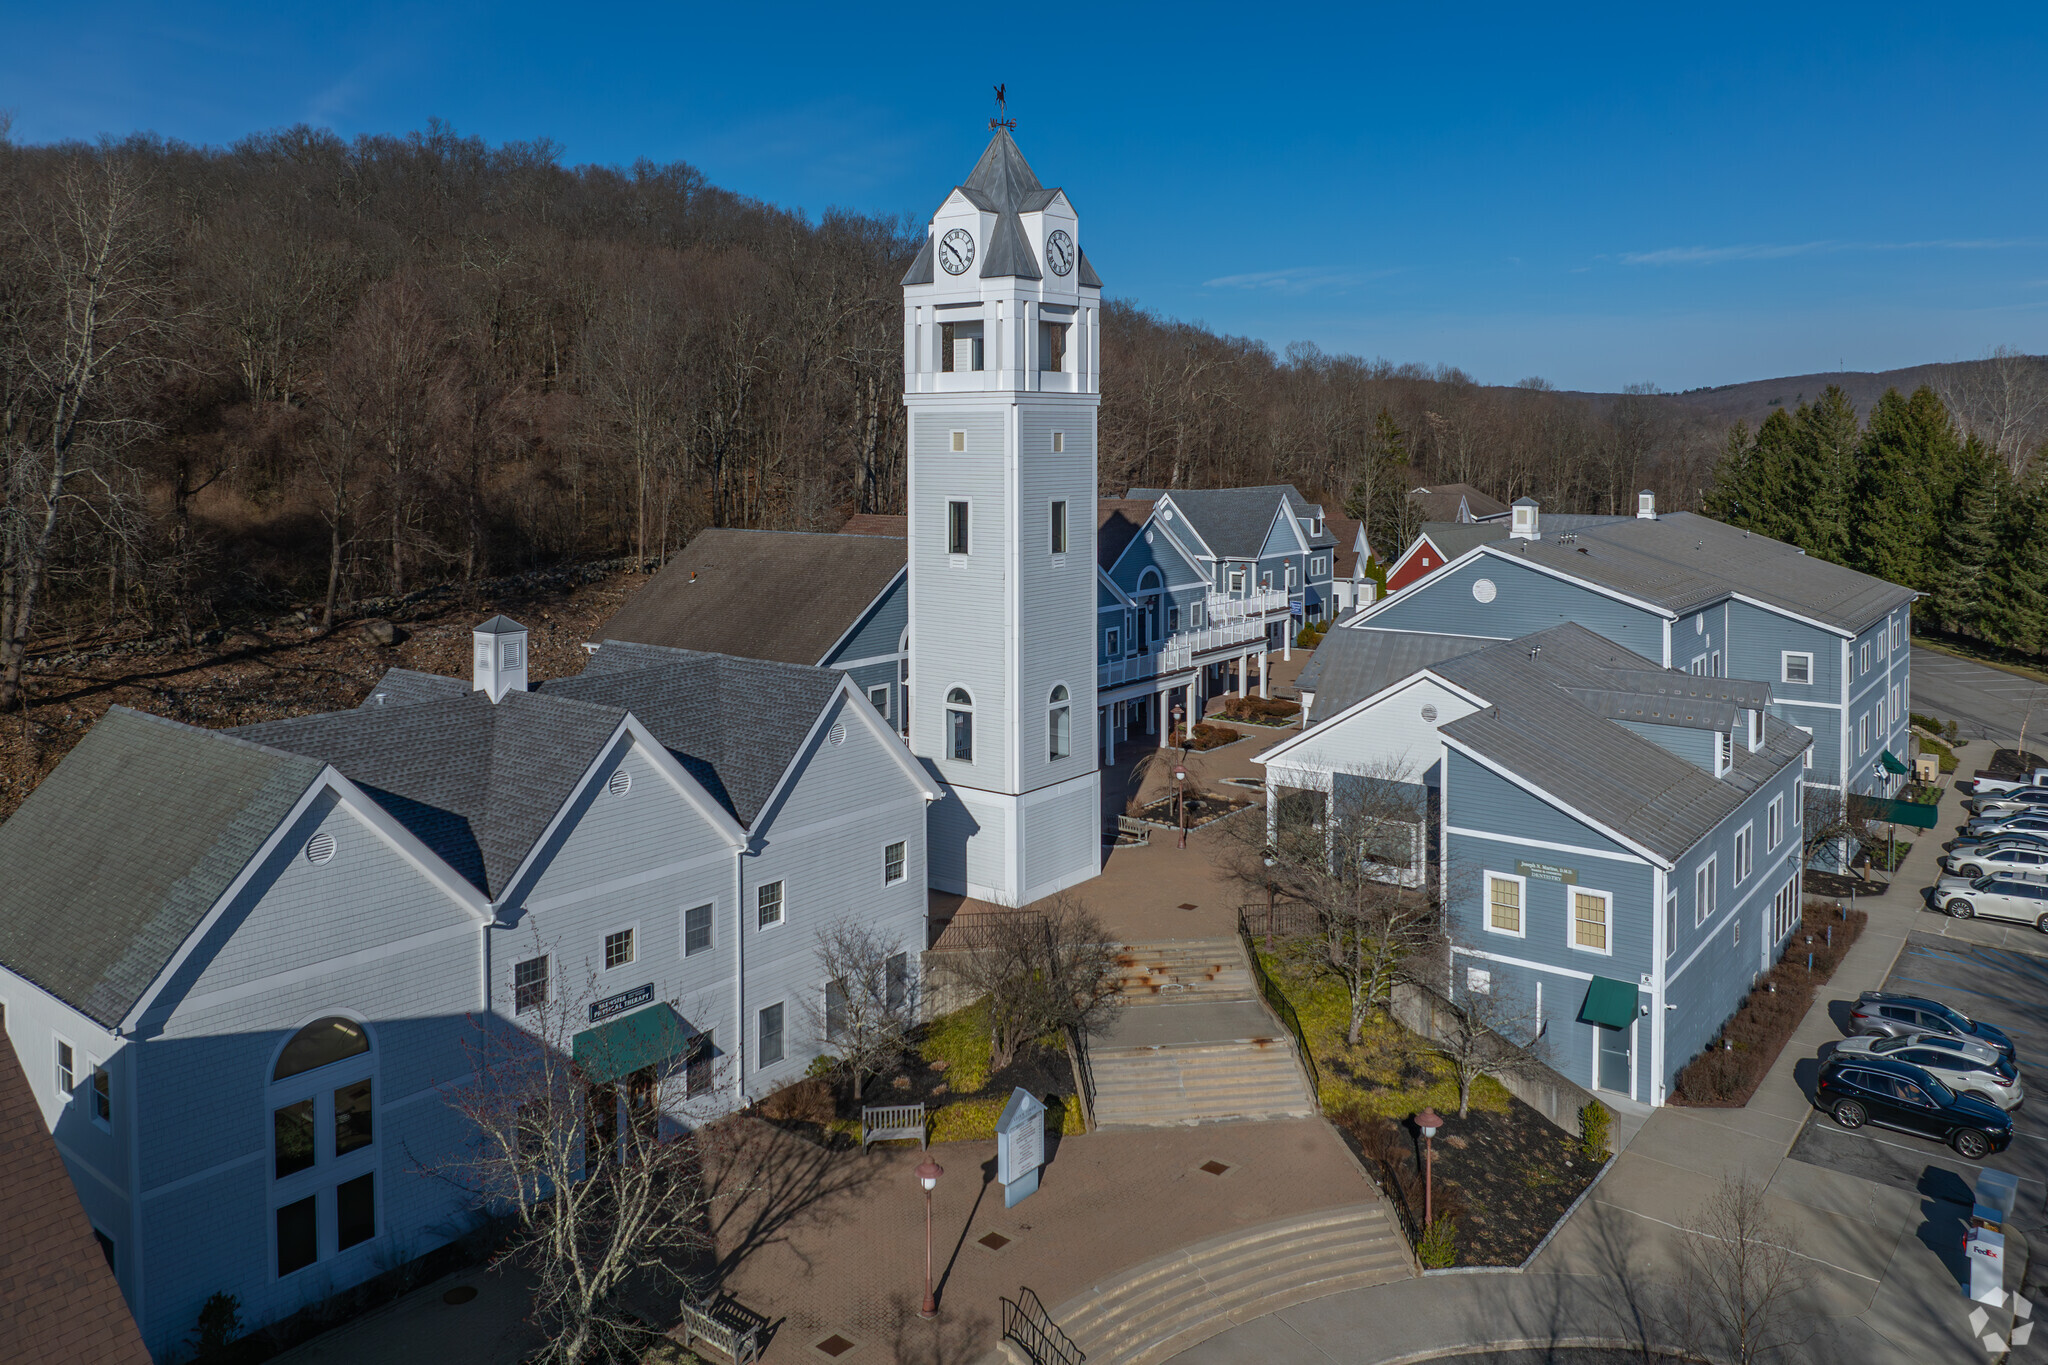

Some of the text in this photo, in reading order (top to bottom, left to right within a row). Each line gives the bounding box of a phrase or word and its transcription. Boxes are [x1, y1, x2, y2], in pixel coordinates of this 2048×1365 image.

[1531, 872, 1562, 881] DENTISTRY
[593, 1003, 623, 1018] PHYSICAL
[624, 992, 650, 1007] THERAPY
[1973, 1246, 1998, 1258] FedEx
